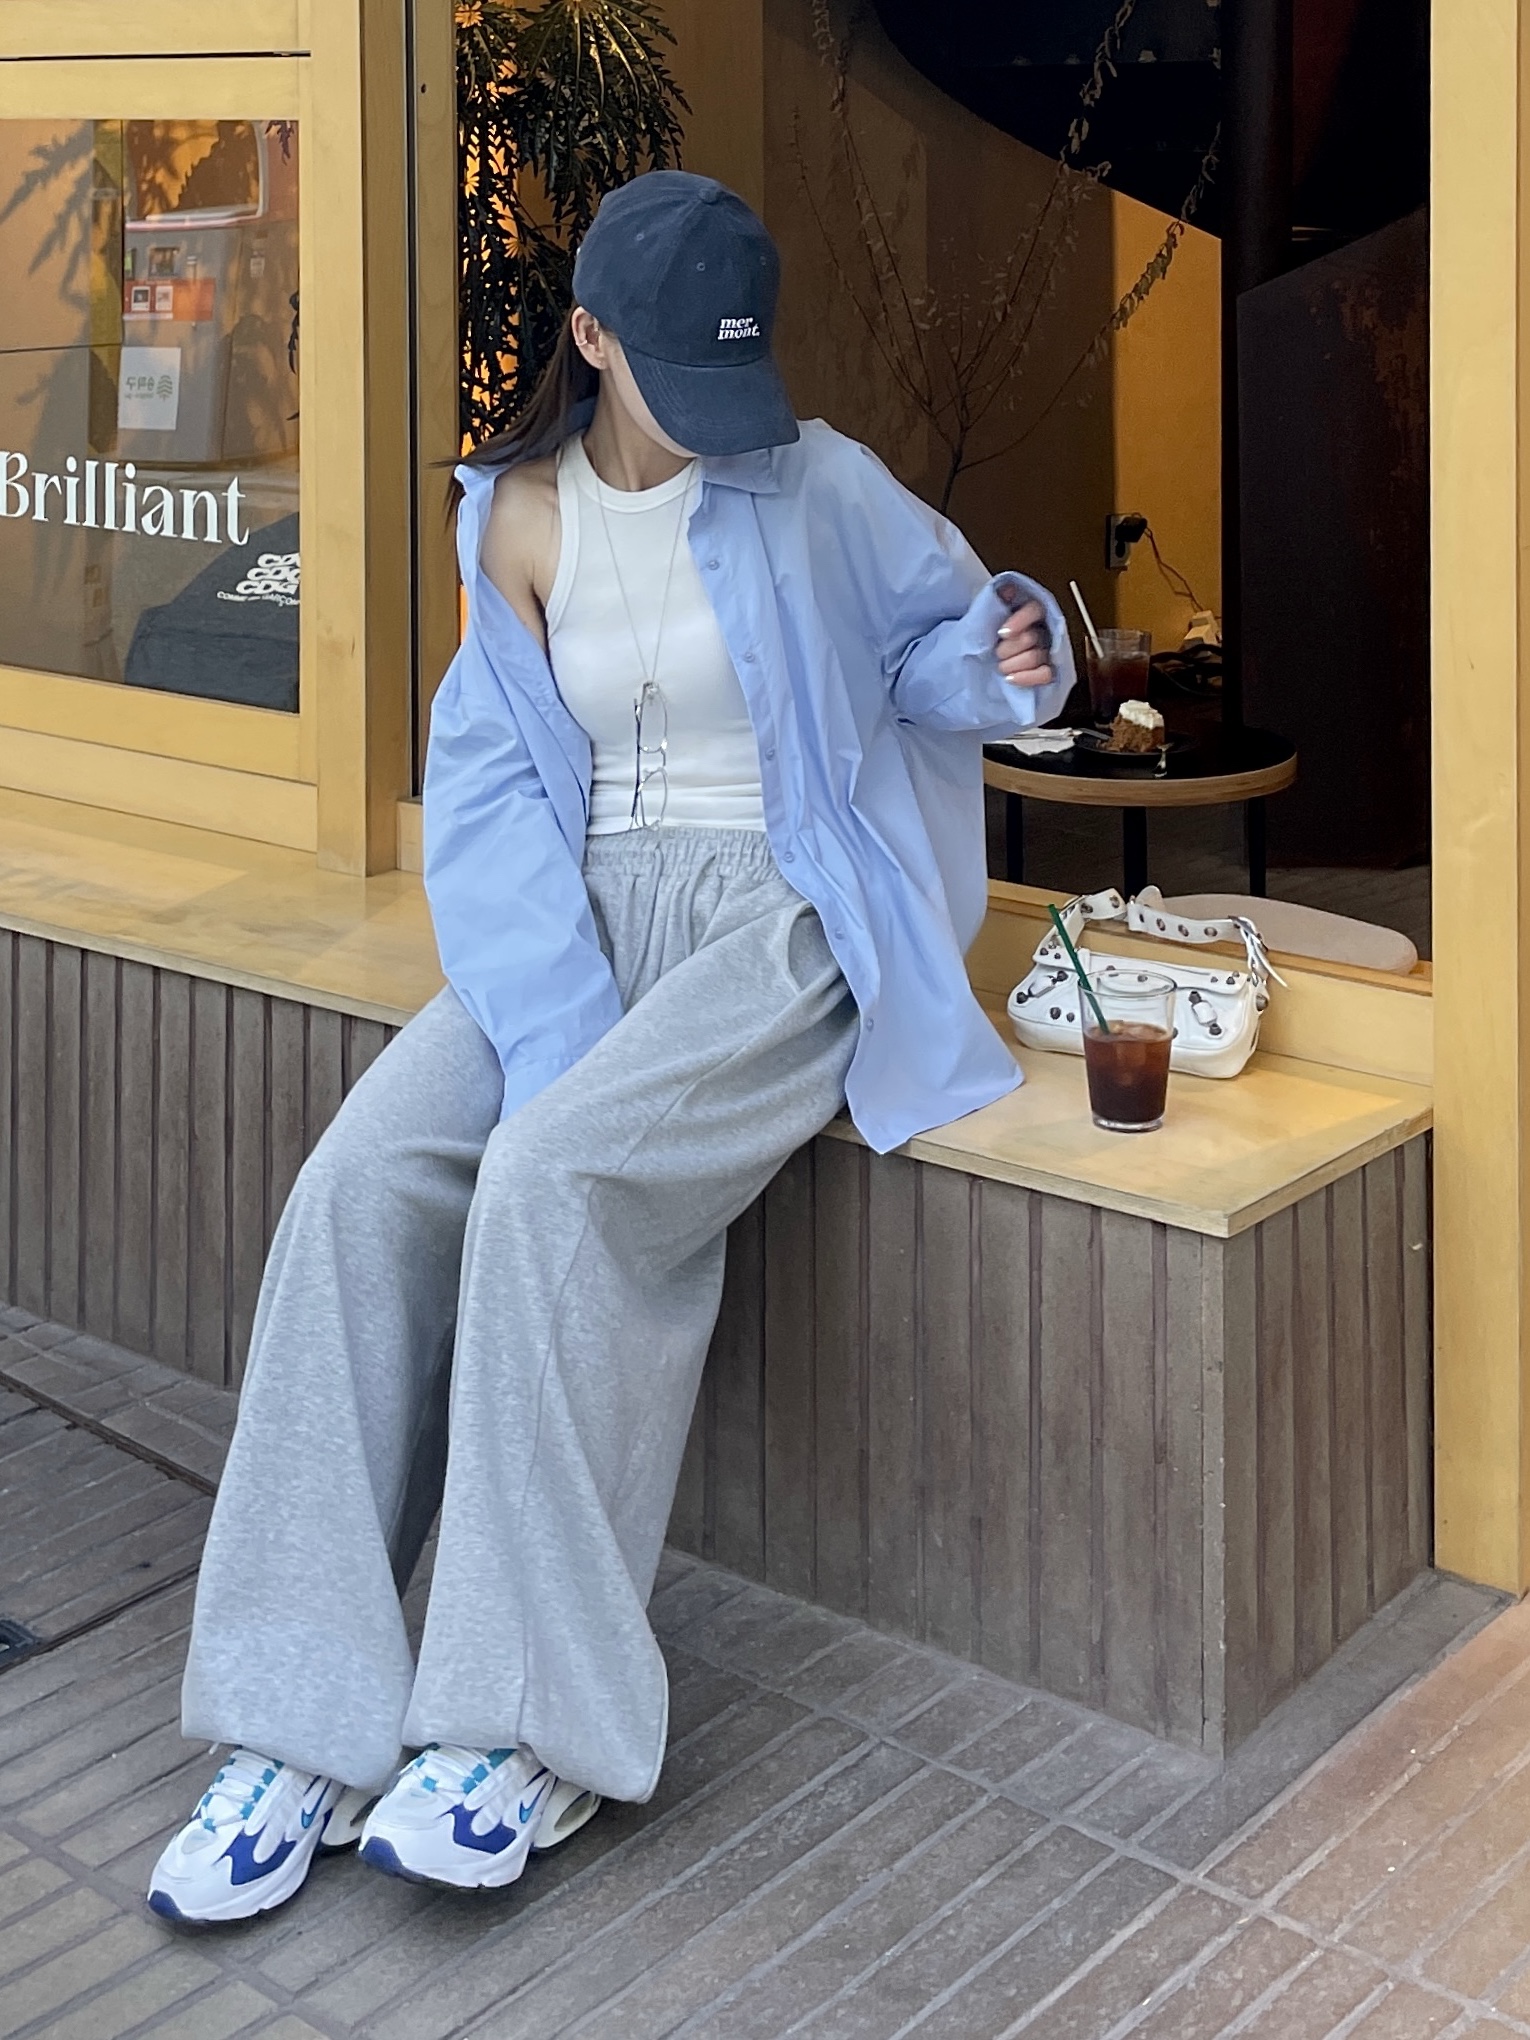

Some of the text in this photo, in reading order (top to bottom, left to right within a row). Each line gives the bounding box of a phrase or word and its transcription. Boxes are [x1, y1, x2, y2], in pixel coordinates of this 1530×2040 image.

[720, 317, 754, 329] mer
[0, 451, 250, 545] Brilliant
[236, 580, 298, 594] CDG
